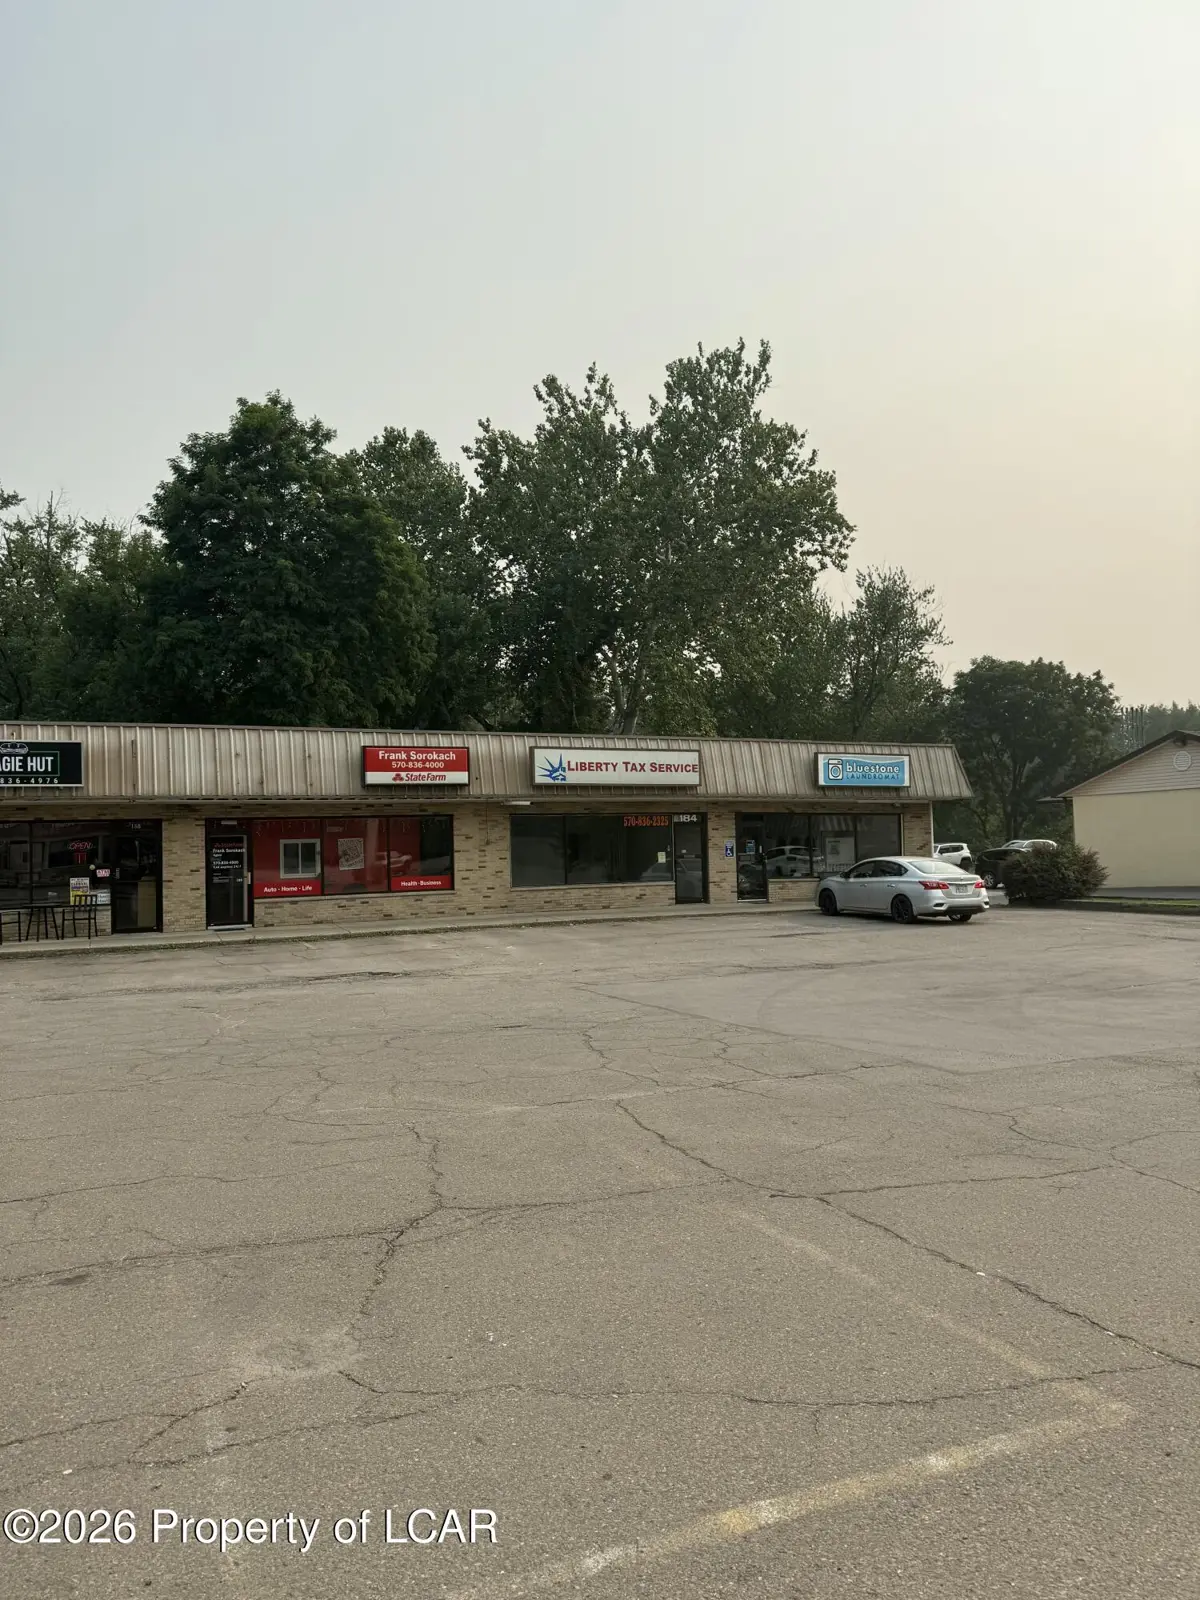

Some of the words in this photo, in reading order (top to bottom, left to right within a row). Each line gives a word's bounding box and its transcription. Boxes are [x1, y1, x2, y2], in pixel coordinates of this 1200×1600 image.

[378, 751, 407, 760] Frank
[410, 751, 456, 760] Sorokach
[0, 756, 23, 772] GIE
[27, 756, 54, 772] HUT
[391, 761, 445, 769] 570-836-4000
[567, 760, 618, 772] LIBERTY
[622, 761, 646, 772] TAX
[649, 762, 698, 773] SERVICE
[846, 762, 900, 773] bluestone
[679, 814, 698, 822] 184
[69, 841, 92, 850] OPEN
